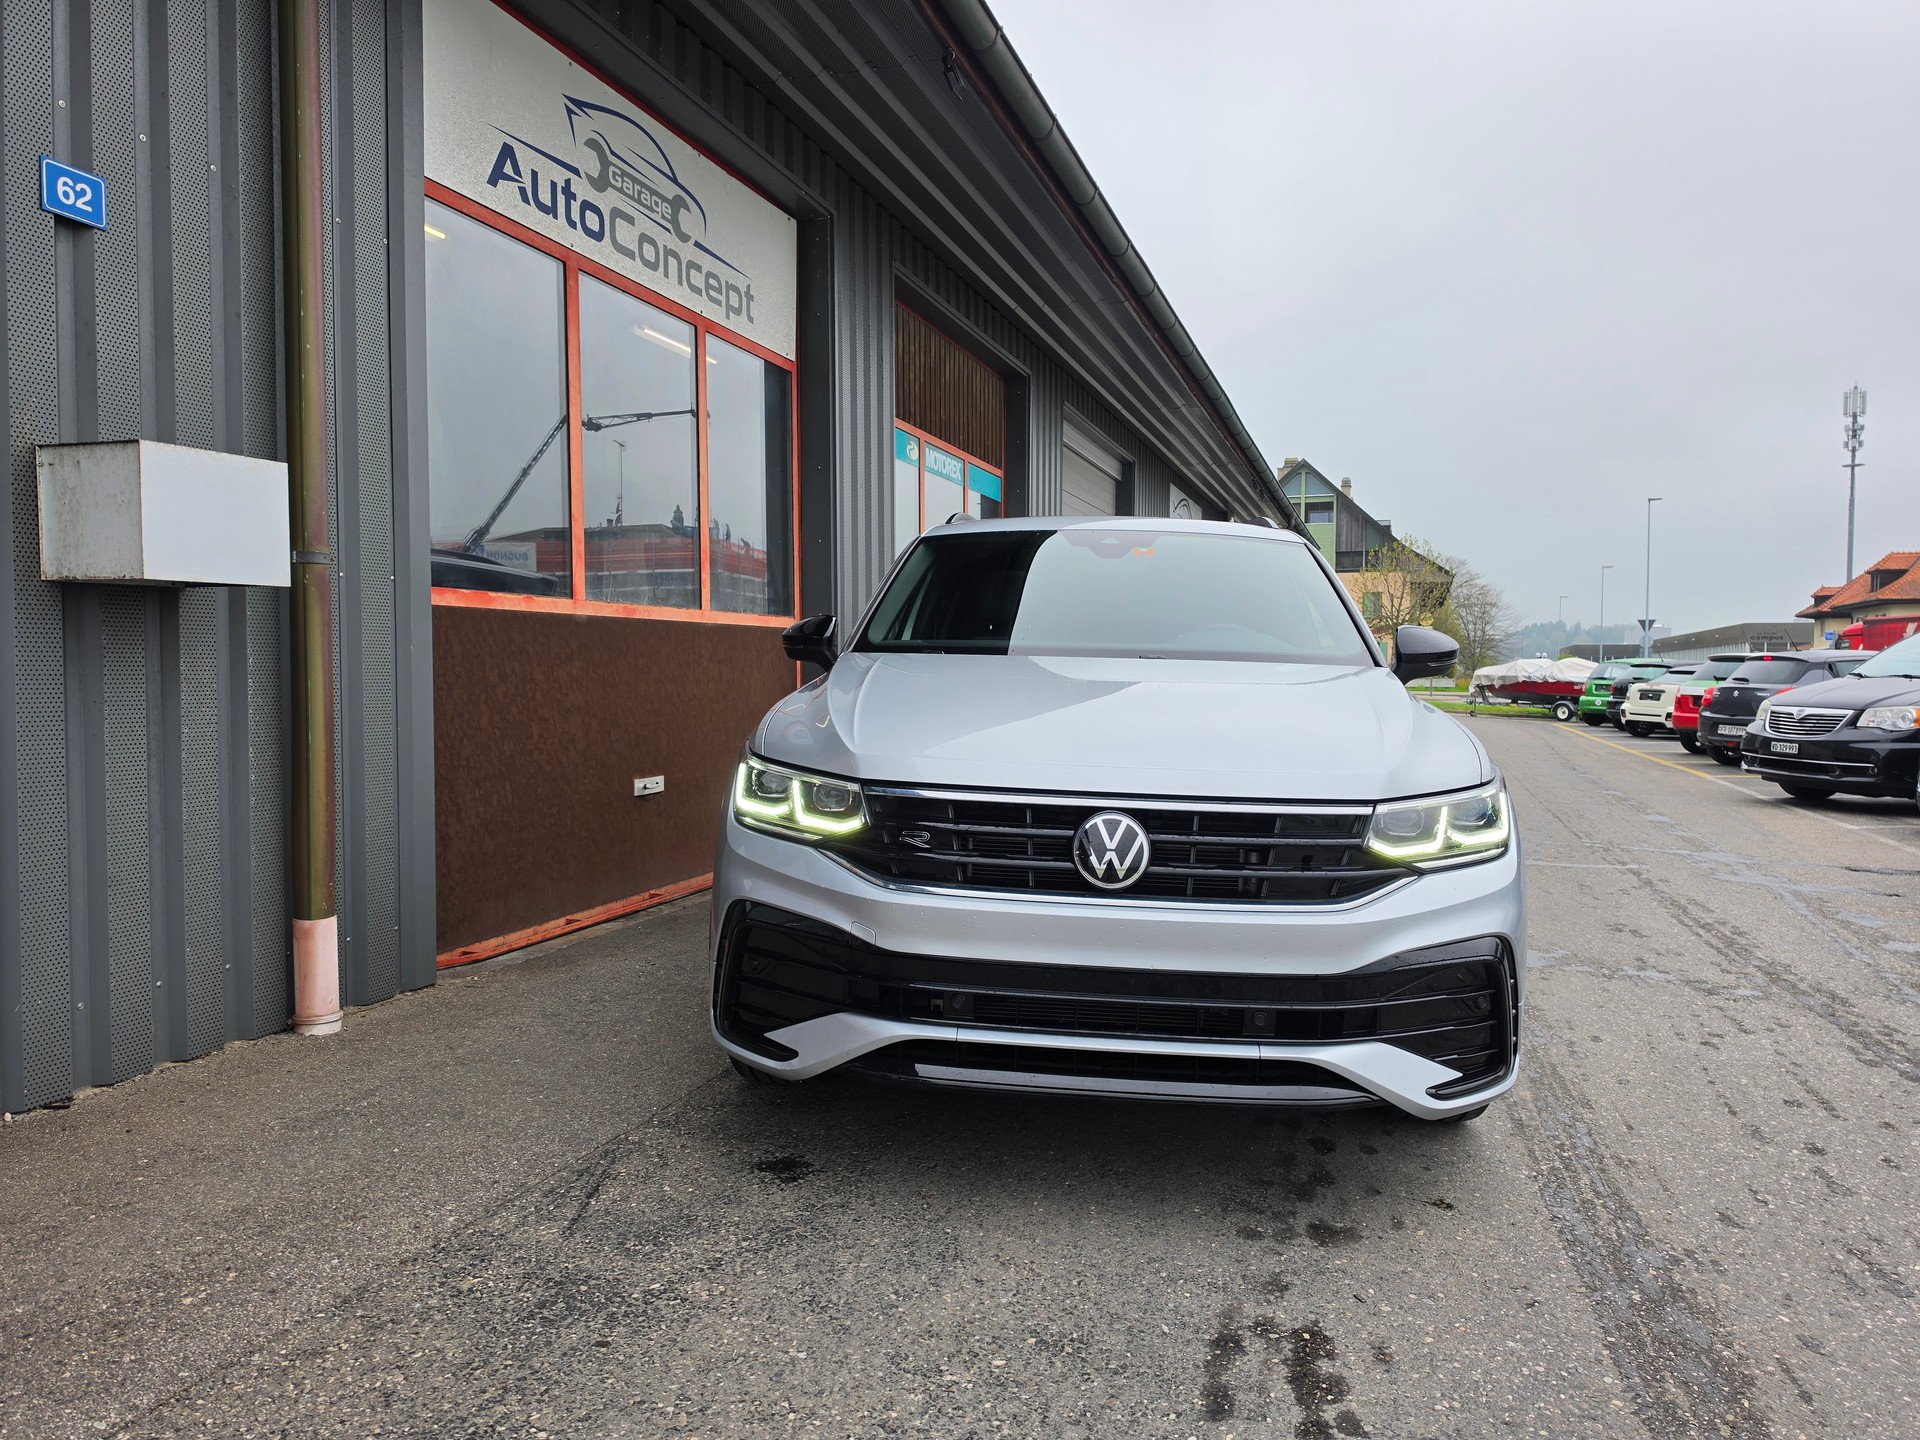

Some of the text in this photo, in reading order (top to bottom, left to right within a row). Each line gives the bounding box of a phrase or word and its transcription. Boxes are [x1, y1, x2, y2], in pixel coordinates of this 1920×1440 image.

[57, 176, 93, 212] 62
[608, 164, 672, 219] Garage
[486, 141, 755, 324] AutoConcept
[925, 447, 962, 481] MOTOREX
